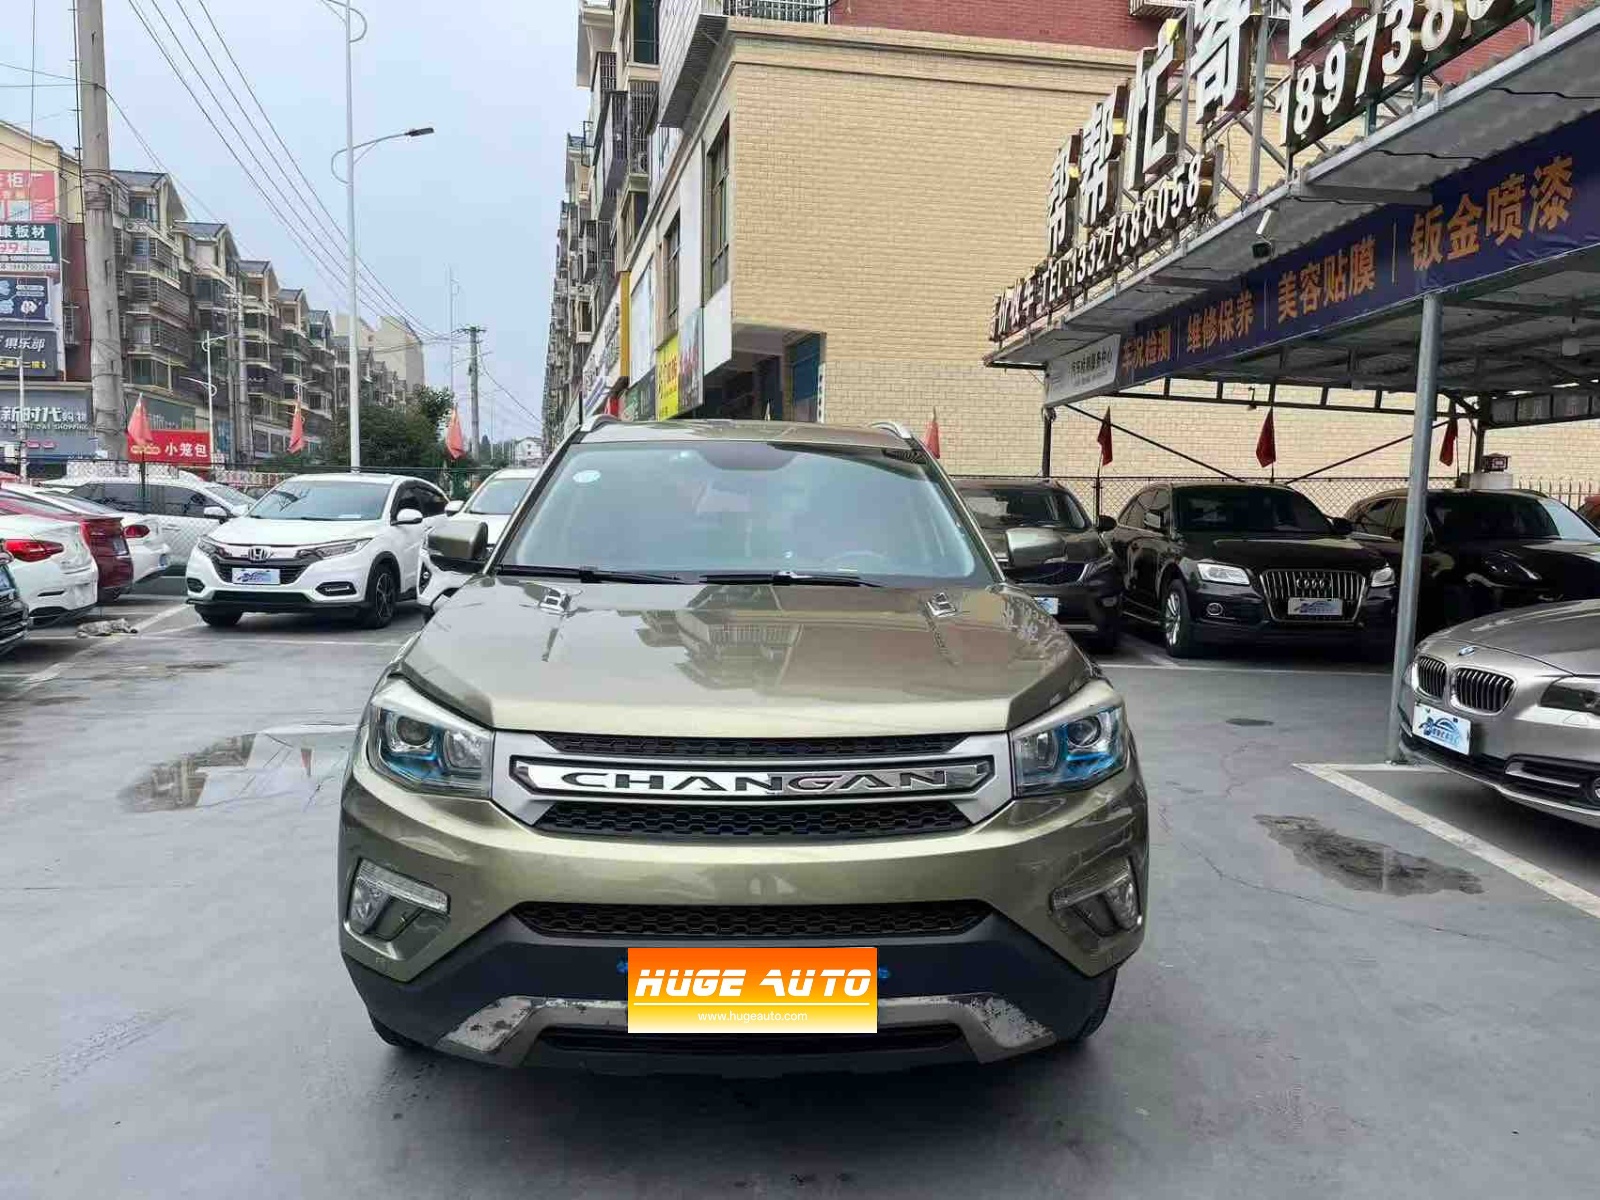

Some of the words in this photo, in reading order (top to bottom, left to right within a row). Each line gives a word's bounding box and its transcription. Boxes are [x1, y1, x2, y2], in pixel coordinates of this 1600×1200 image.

[1121, 324, 1172, 374] 车况检测
[1186, 289, 1255, 353] 维修保养
[1276, 233, 1377, 324] 美容贴膜
[1410, 155, 1573, 271] 钣金喷漆
[164, 438, 208, 457] 小笼包
[561, 770, 948, 794] CHANGAN
